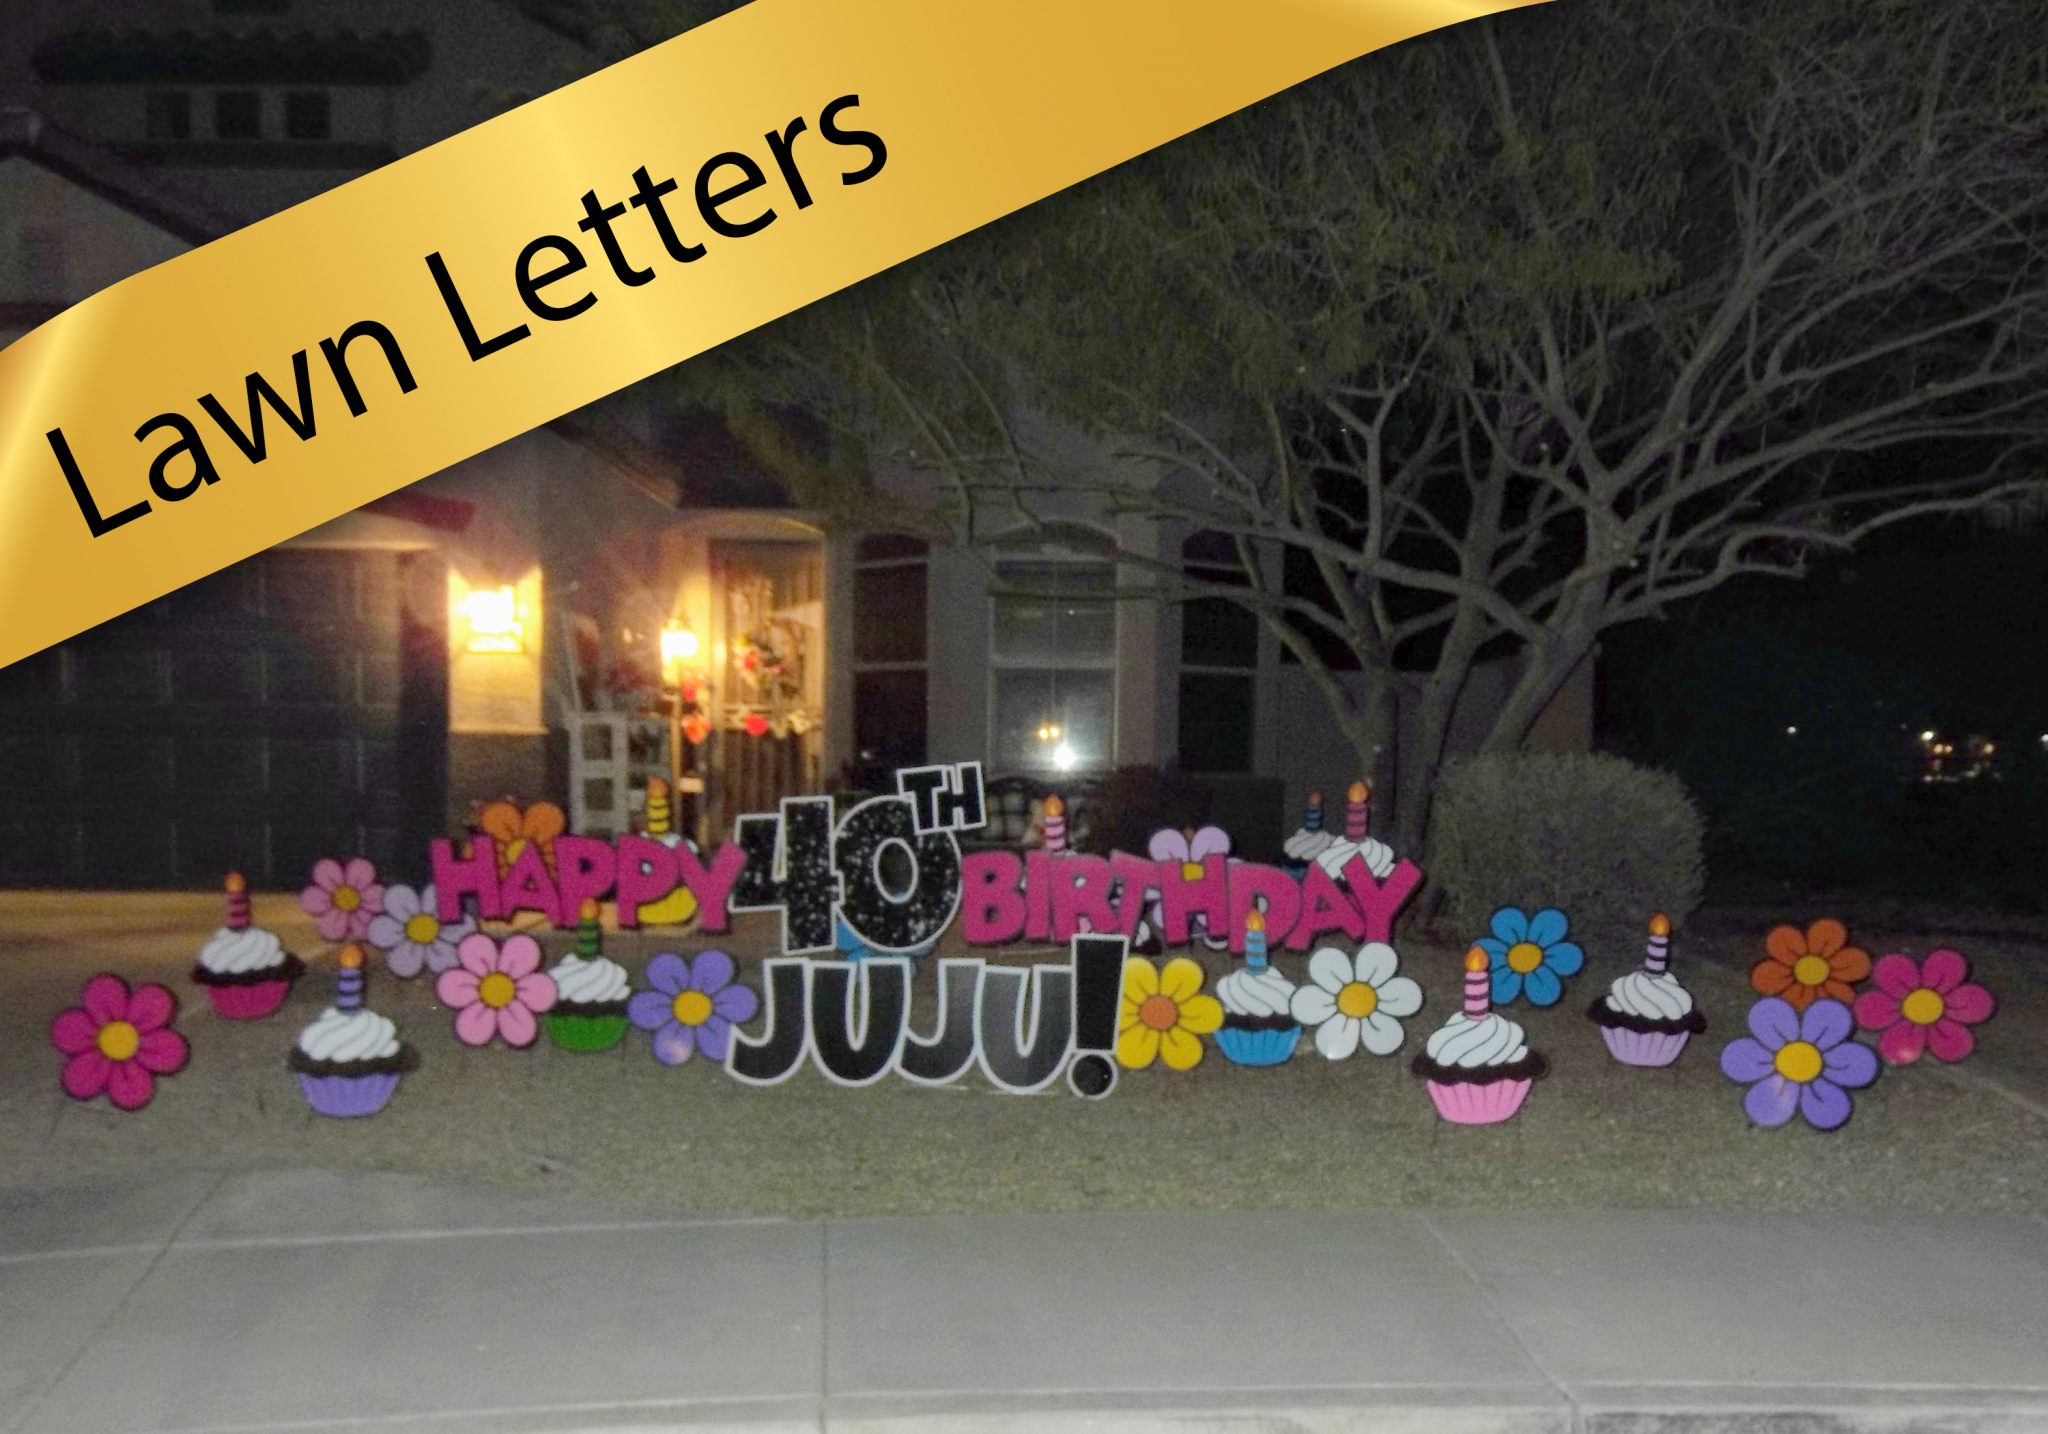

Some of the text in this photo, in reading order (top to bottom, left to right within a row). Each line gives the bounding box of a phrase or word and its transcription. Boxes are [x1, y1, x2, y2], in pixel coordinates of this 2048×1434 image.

[430, 834, 748, 934] HAPPY
[961, 849, 1423, 954] BIRTHDAY
[725, 933, 1129, 1099] JUJU!
